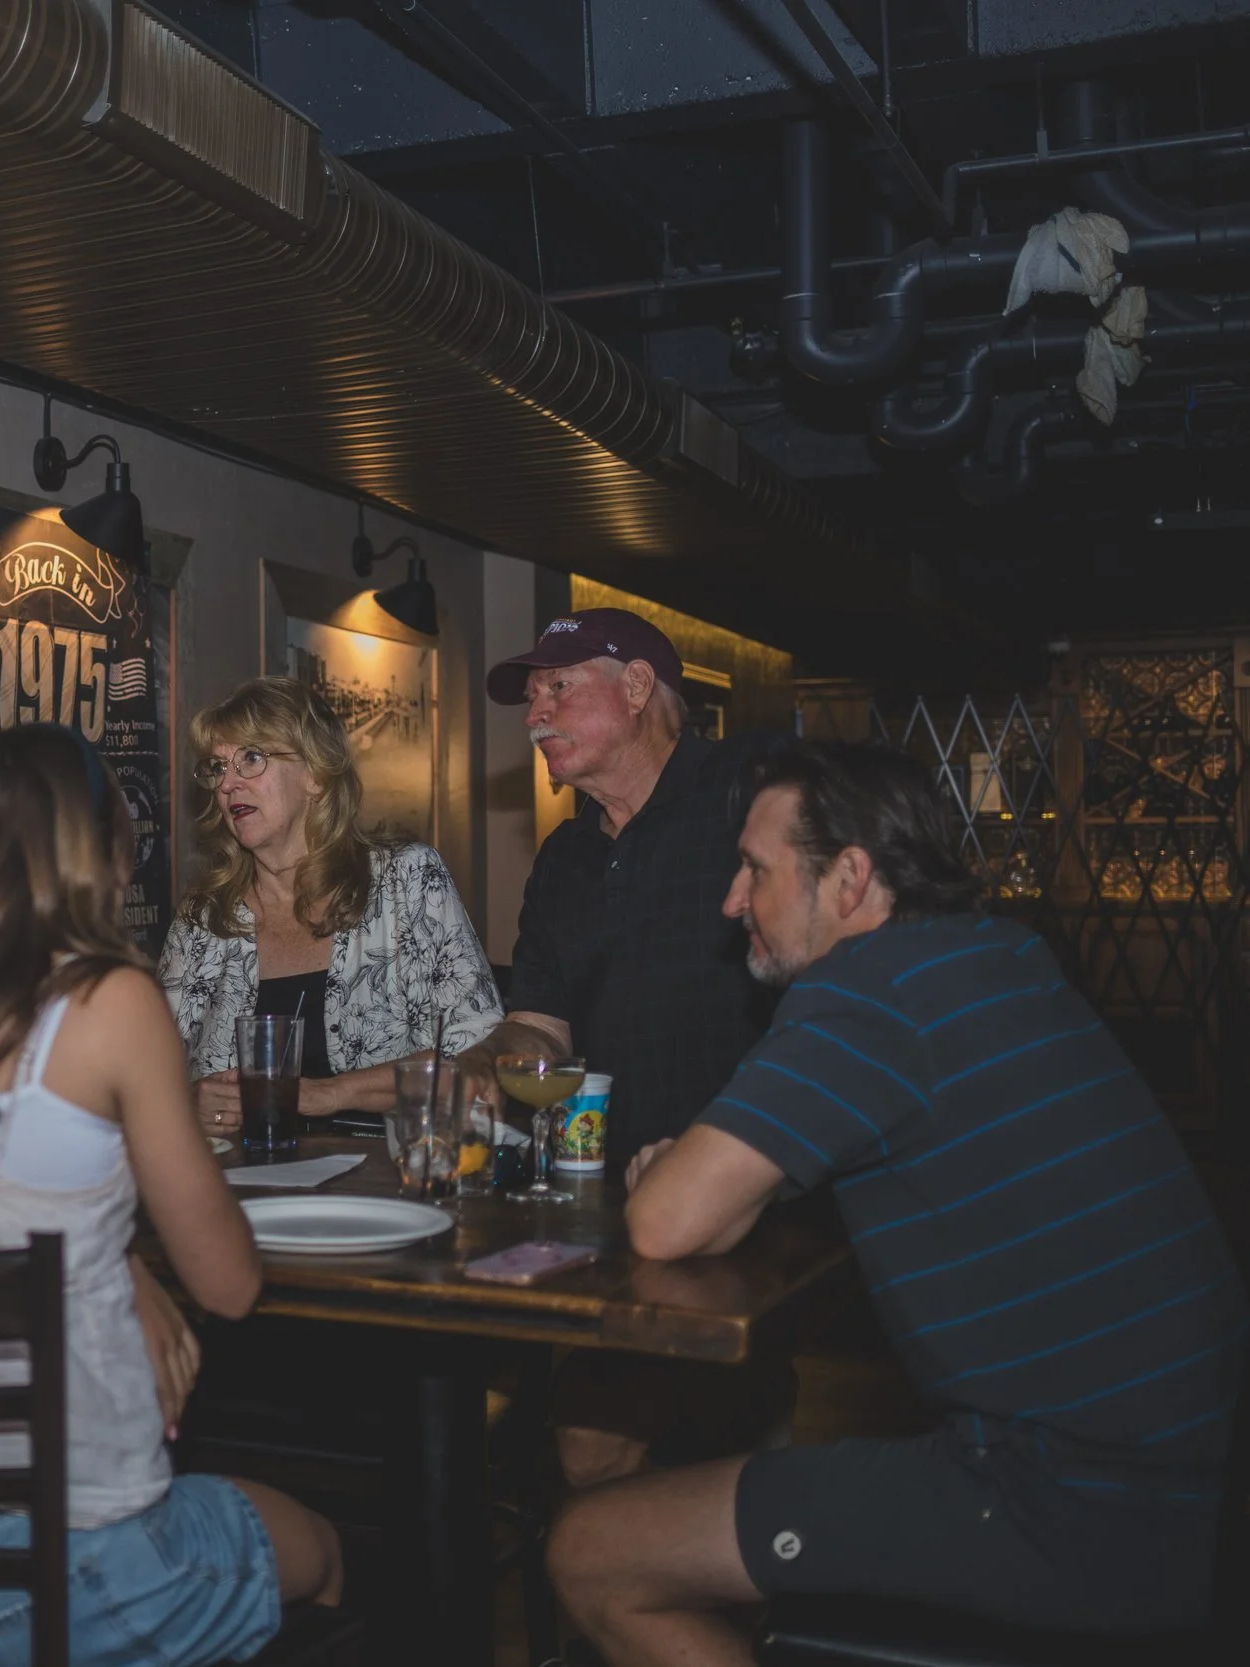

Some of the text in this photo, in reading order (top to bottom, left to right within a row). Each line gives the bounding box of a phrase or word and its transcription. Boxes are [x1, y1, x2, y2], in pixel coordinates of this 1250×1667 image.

[5, 552, 96, 608] Back in
[105, 719, 130, 734] Yearly
[123, 904, 159, 926] SIDENT
